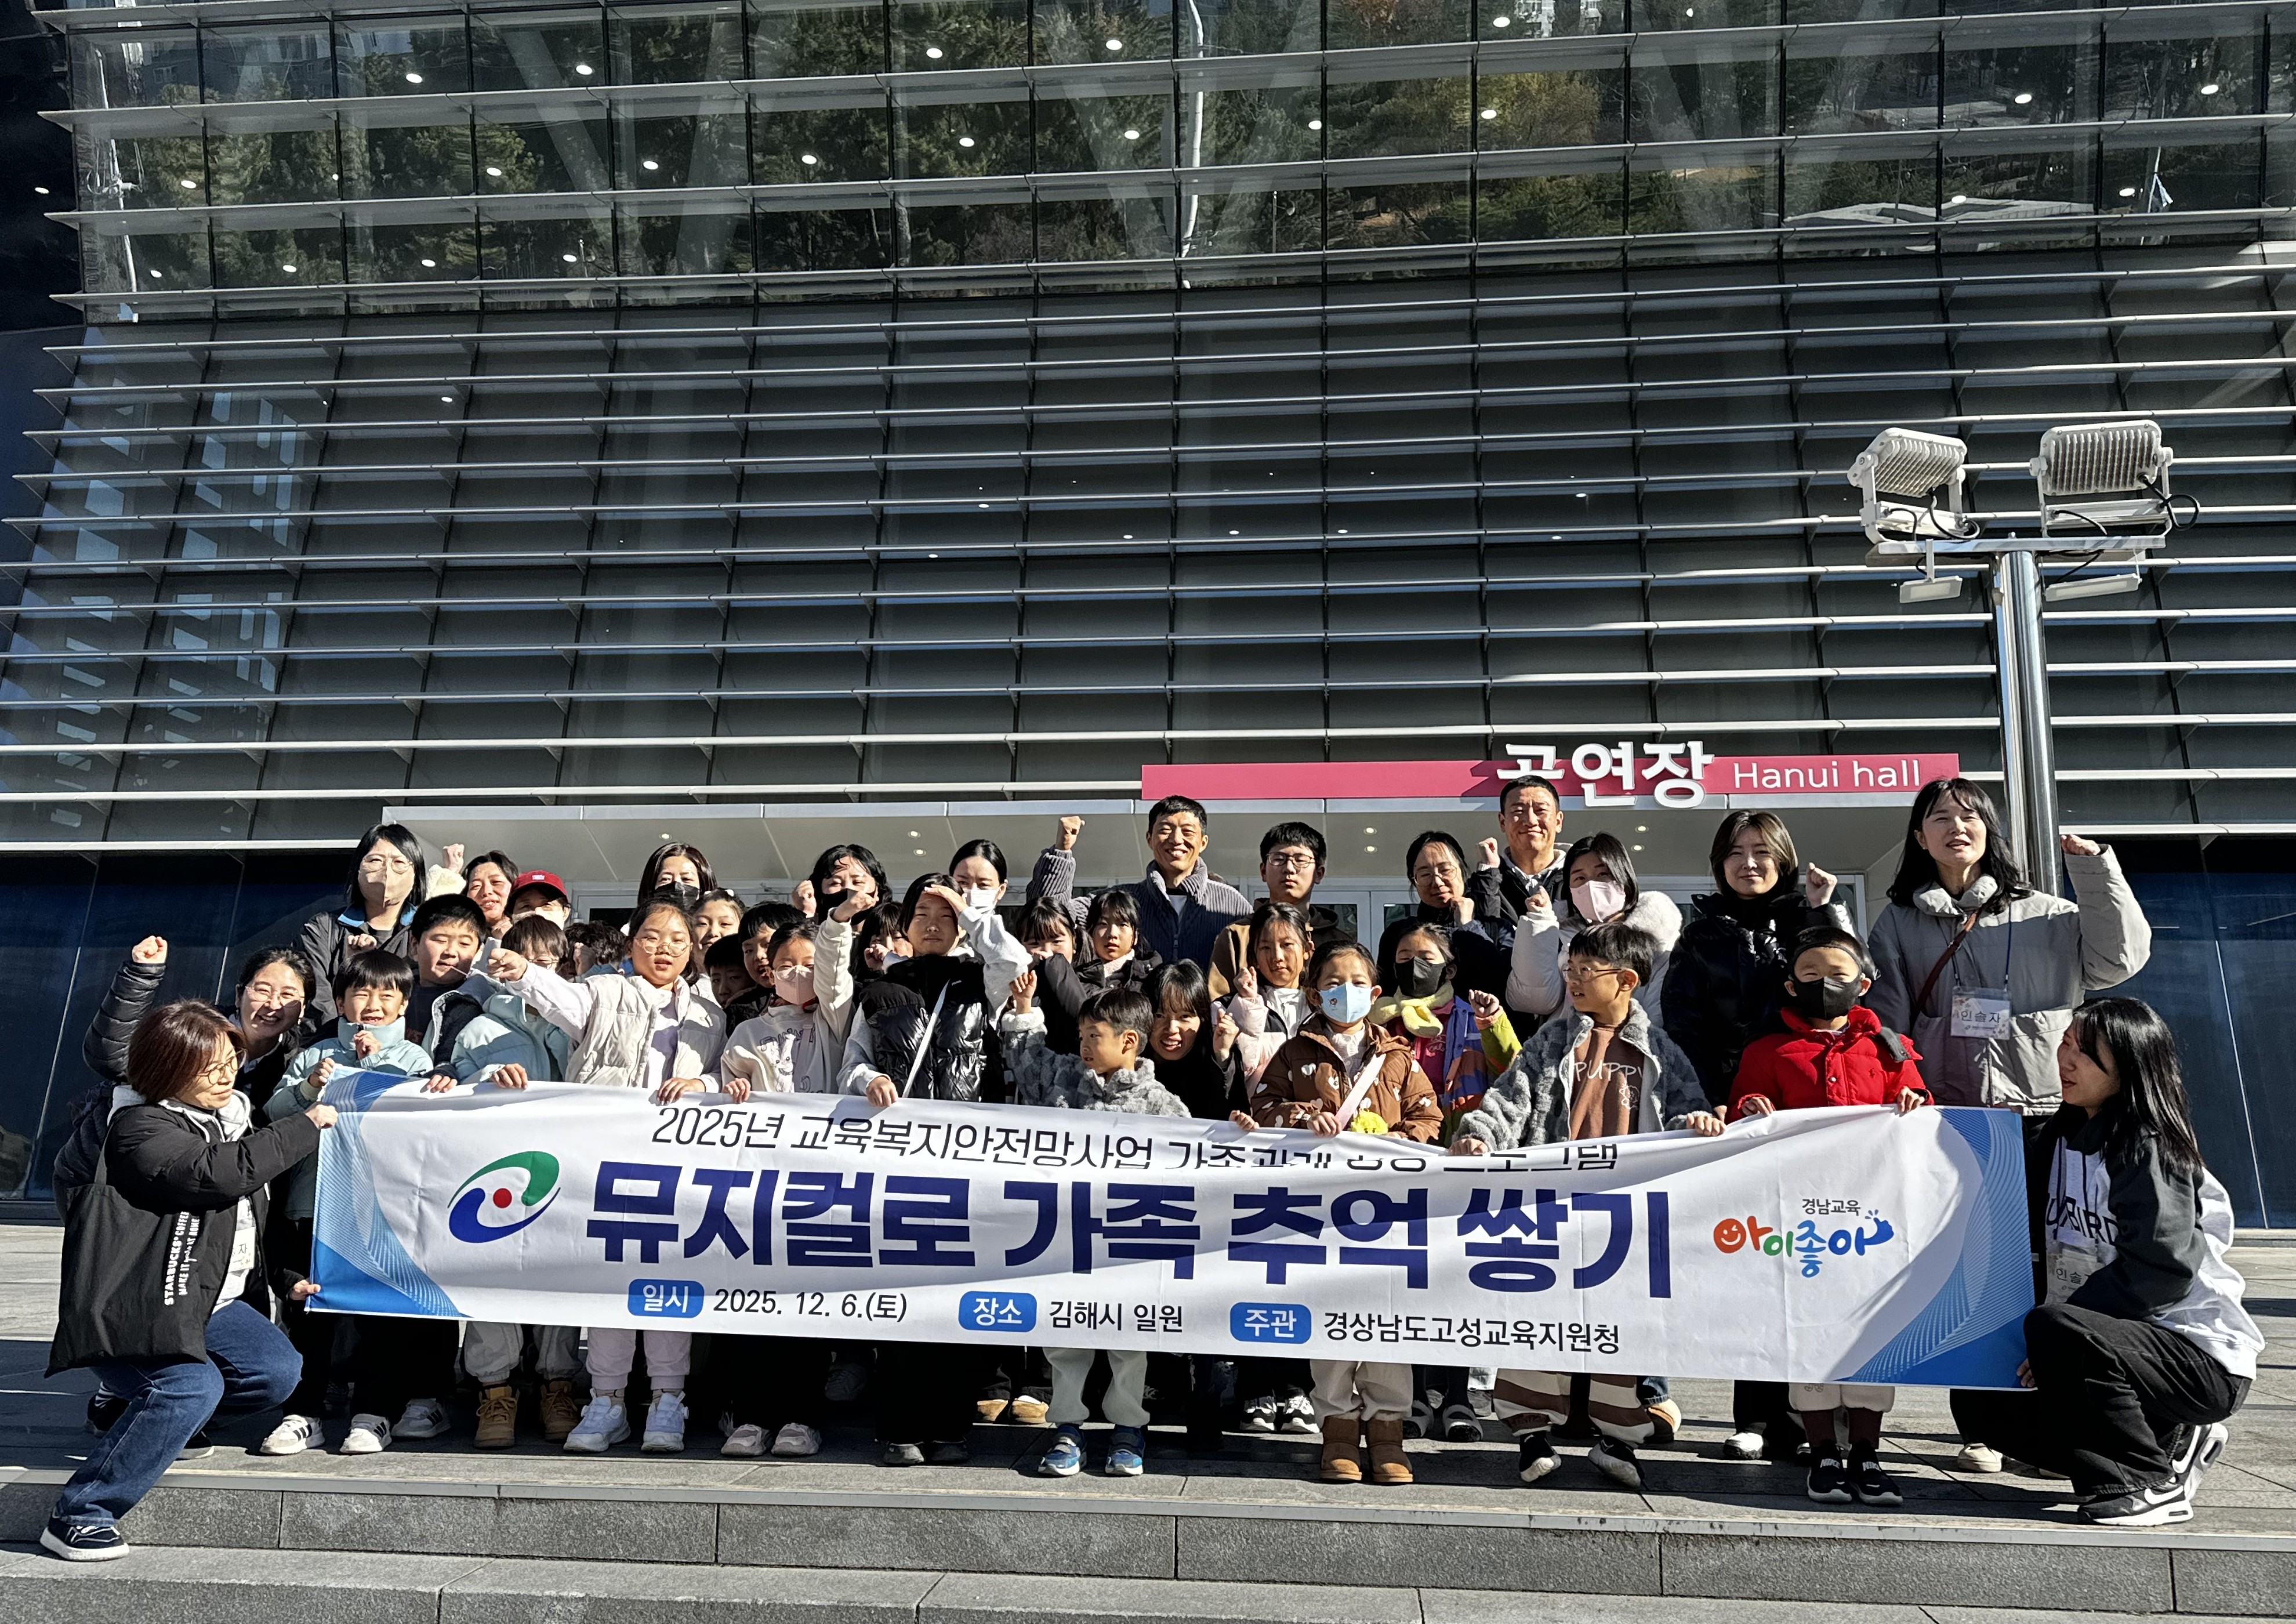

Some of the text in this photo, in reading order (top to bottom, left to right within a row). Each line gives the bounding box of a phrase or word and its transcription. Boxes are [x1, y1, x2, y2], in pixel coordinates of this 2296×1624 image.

[1734, 760, 1920, 788] Hanui hall
[652, 1107, 785, 1148] 2025년
[790, 1116, 1152, 1170] 교육복지안전망사업
[1802, 1198, 1860, 1216] 경남교육
[586, 1161, 1671, 1299] 뮤지컬로 가족 추억 쌓기
[1713, 1216, 1894, 1278] 아이좋아
[642, 1284, 688, 1313] 일시
[713, 1288, 907, 1322] 2025. 12. 6.(토)
[973, 1297, 1022, 1326] 장소
[1049, 1301, 1183, 1333] 김해시 일원
[1244, 1310, 1297, 1338] 주관
[1324, 1312, 1619, 1354] 경상남도고성교육지원청
